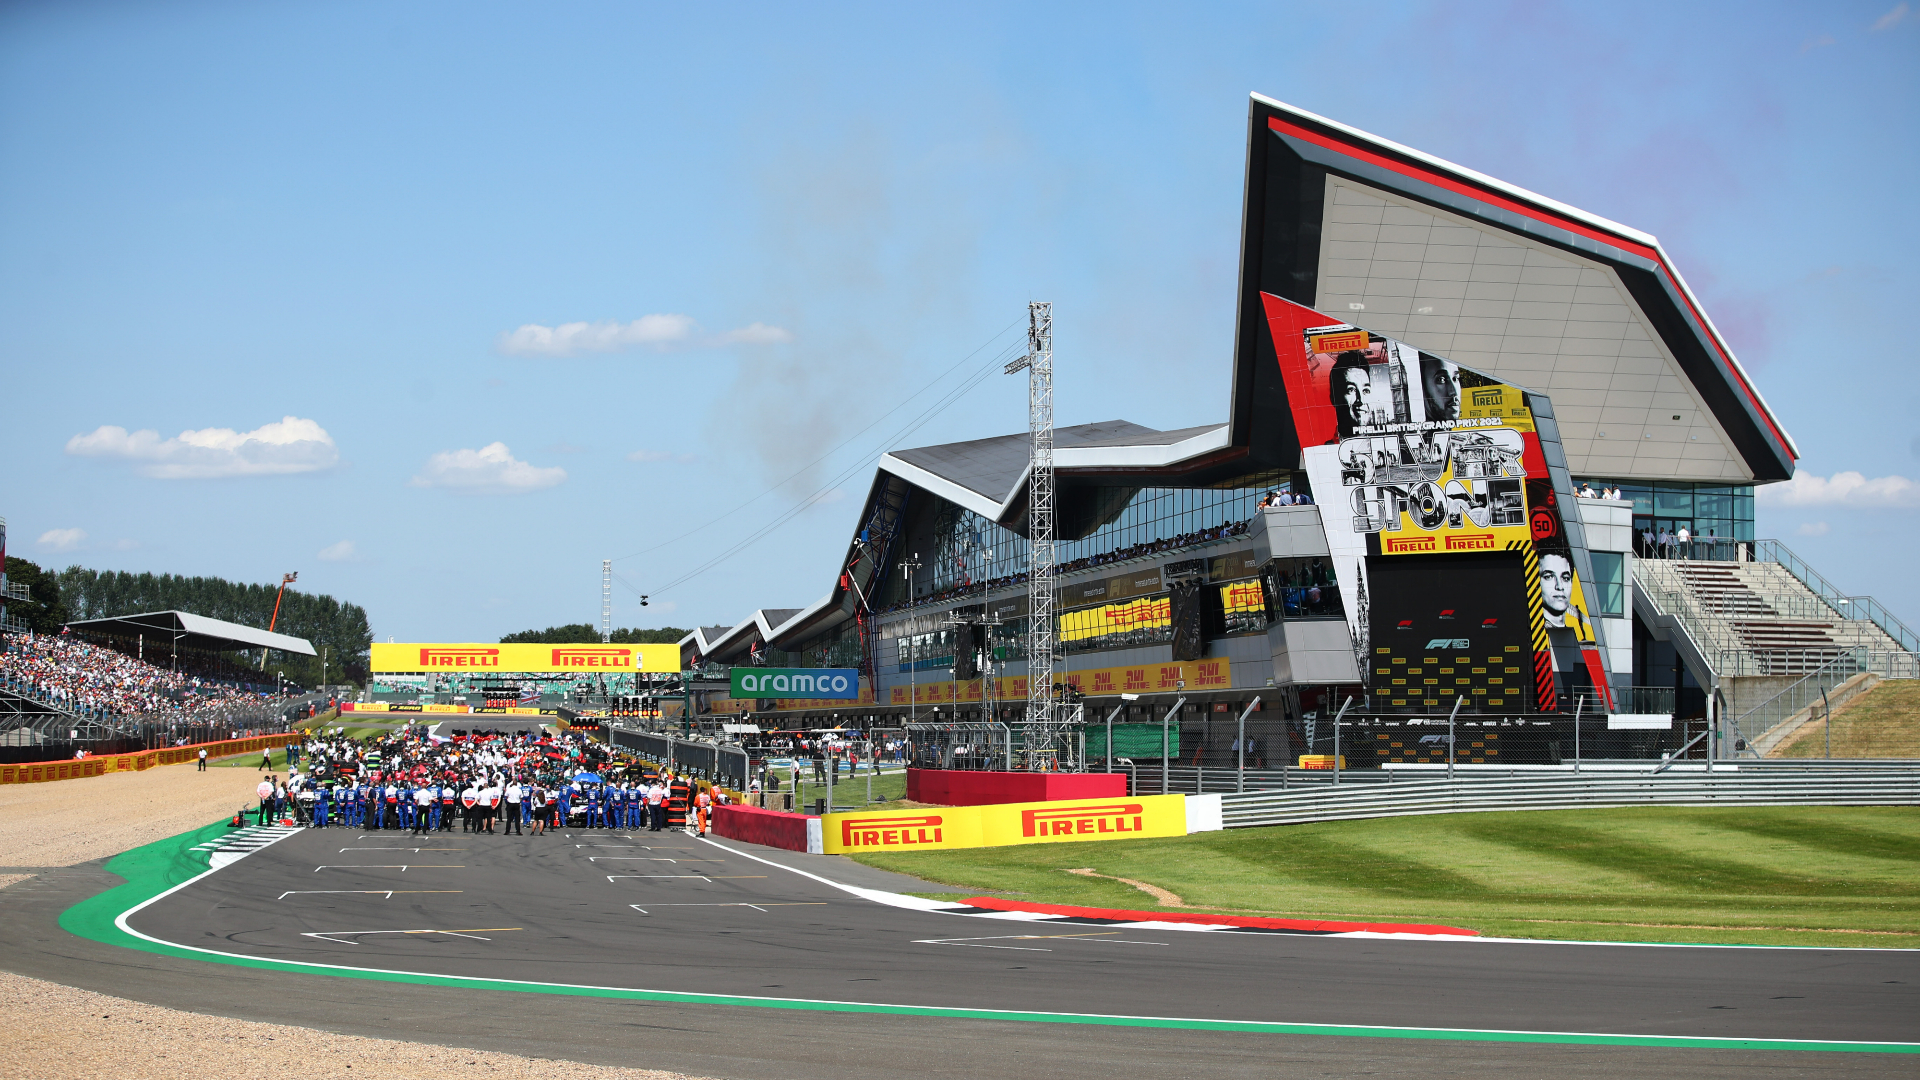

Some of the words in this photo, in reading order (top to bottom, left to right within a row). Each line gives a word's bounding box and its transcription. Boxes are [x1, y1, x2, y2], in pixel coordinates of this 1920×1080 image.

[1318, 334, 1361, 351] PIRELLI
[1472, 388, 1503, 406] PIRELLI
[1353, 425, 1386, 435] PIRELLI
[1386, 422, 1422, 433] BRITISH
[1422, 420, 1456, 431] GRAND
[1456, 418, 1478, 429] PRIX
[1478, 417, 1503, 426] 2021
[1338, 427, 1527, 487] SILVER
[1350, 477, 1527, 534] STONE
[1387, 536, 1435, 552] PIRELLI
[1445, 534, 1495, 550] PIRELLI
[420, 648, 500, 667] PIRELLI
[552, 648, 631, 667] PIRELLI
[741, 674, 848, 692] aramco
[1092, 672, 1116, 691] DHL
[1123, 669, 1150, 689] DHL
[1157, 666, 1186, 688] DHL
[1194, 662, 1227, 685] DHL
[1022, 803, 1144, 837] PIRELLI
[842, 815, 943, 846] PIRELLI
